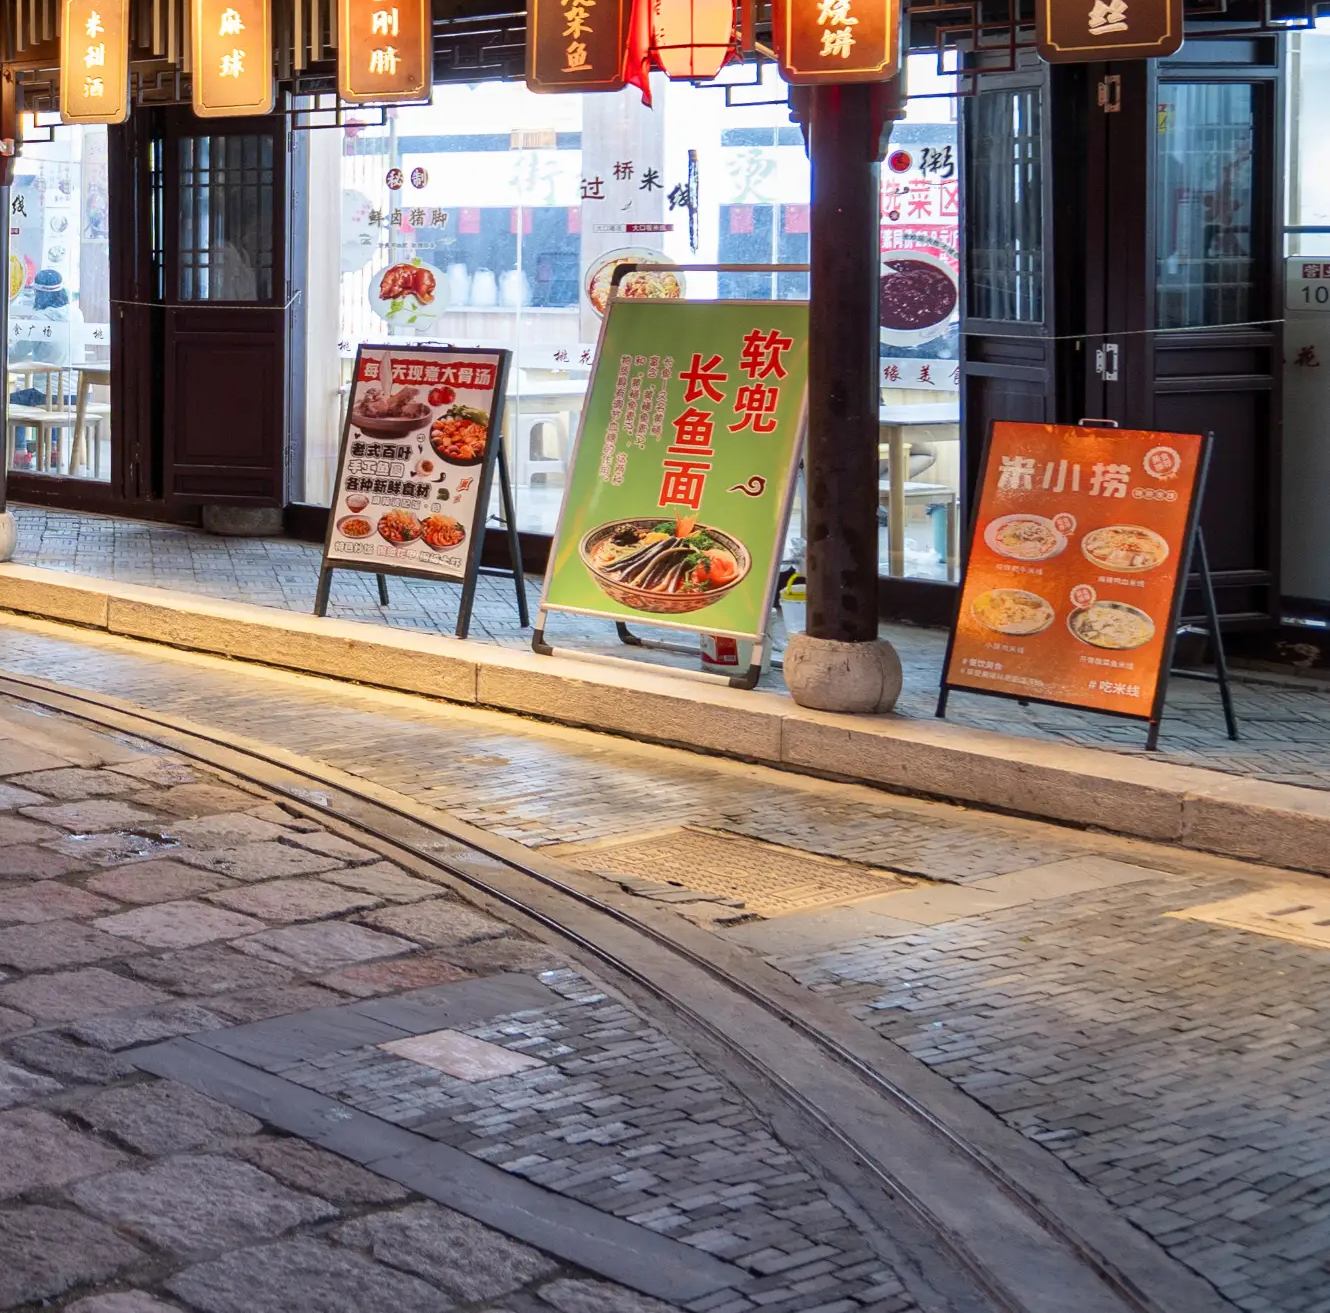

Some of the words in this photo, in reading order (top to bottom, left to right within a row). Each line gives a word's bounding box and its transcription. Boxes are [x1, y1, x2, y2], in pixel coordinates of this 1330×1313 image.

[217, 6, 247, 79] 麻球
[386, 167, 429, 190] 秘制
[368, 207, 448, 228] 鲜卤猪脚
[363, 361, 492, 386] 每天现煮大骨汤
[726, 327, 795, 435] 软兜
[657, 352, 730, 511] 长鱼面
[350, 440, 413, 462] 老式百叶
[344, 476, 432, 500] 各种新鲜食材
